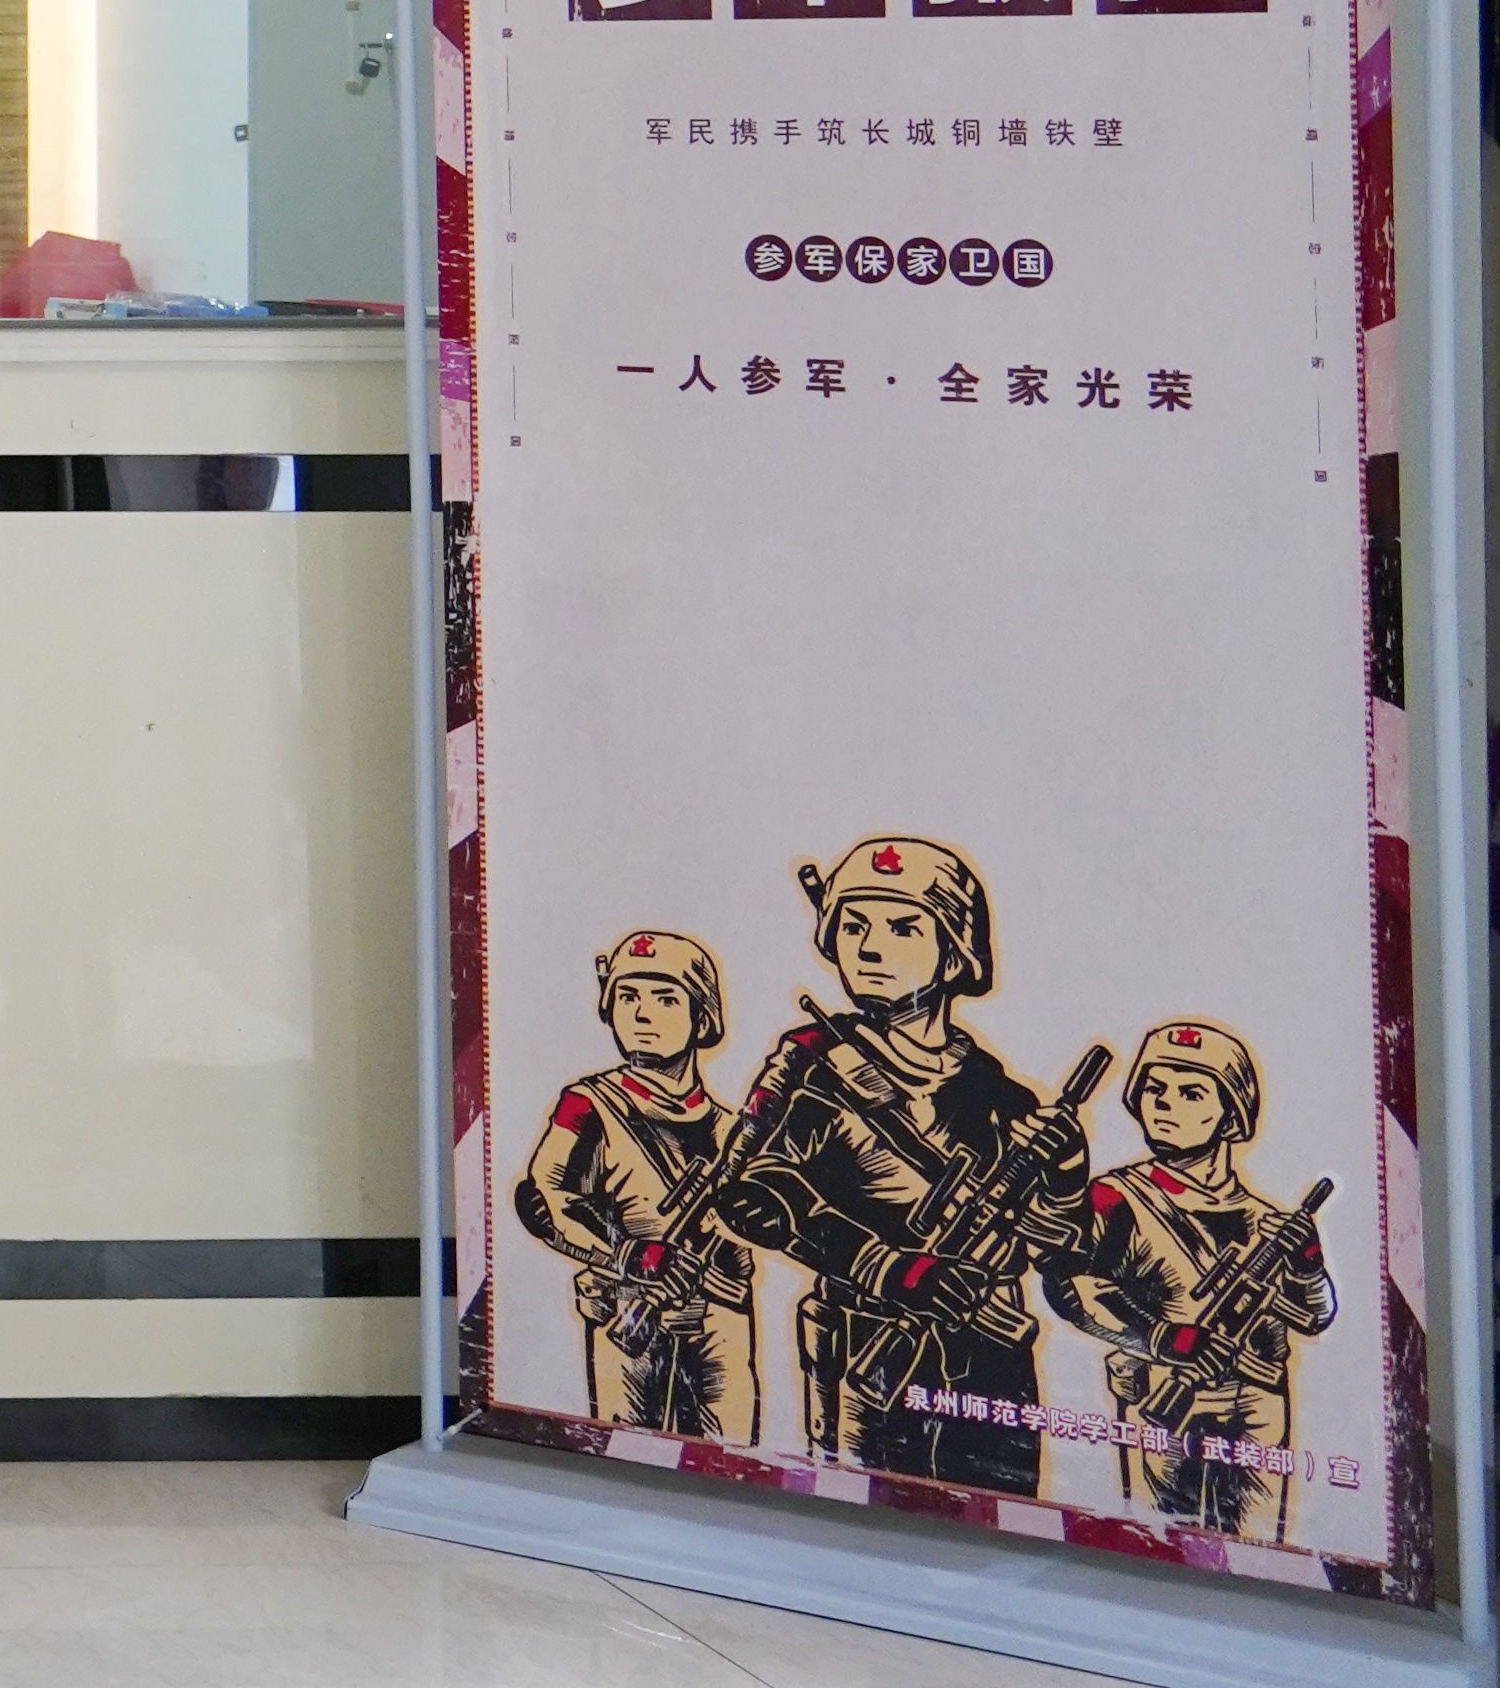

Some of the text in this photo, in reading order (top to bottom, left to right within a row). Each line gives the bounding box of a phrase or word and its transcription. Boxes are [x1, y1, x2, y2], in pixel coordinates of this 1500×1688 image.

[645, 116, 1125, 148] 军民携手筑长城铜墙铁壁
[750, 242, 1049, 281] 参军保家卫国
[616, 353, 1195, 413] 一人参军·全家光荣
[903, 1384, 1362, 1490] 泉州师范学院学工部（武装部）宣
